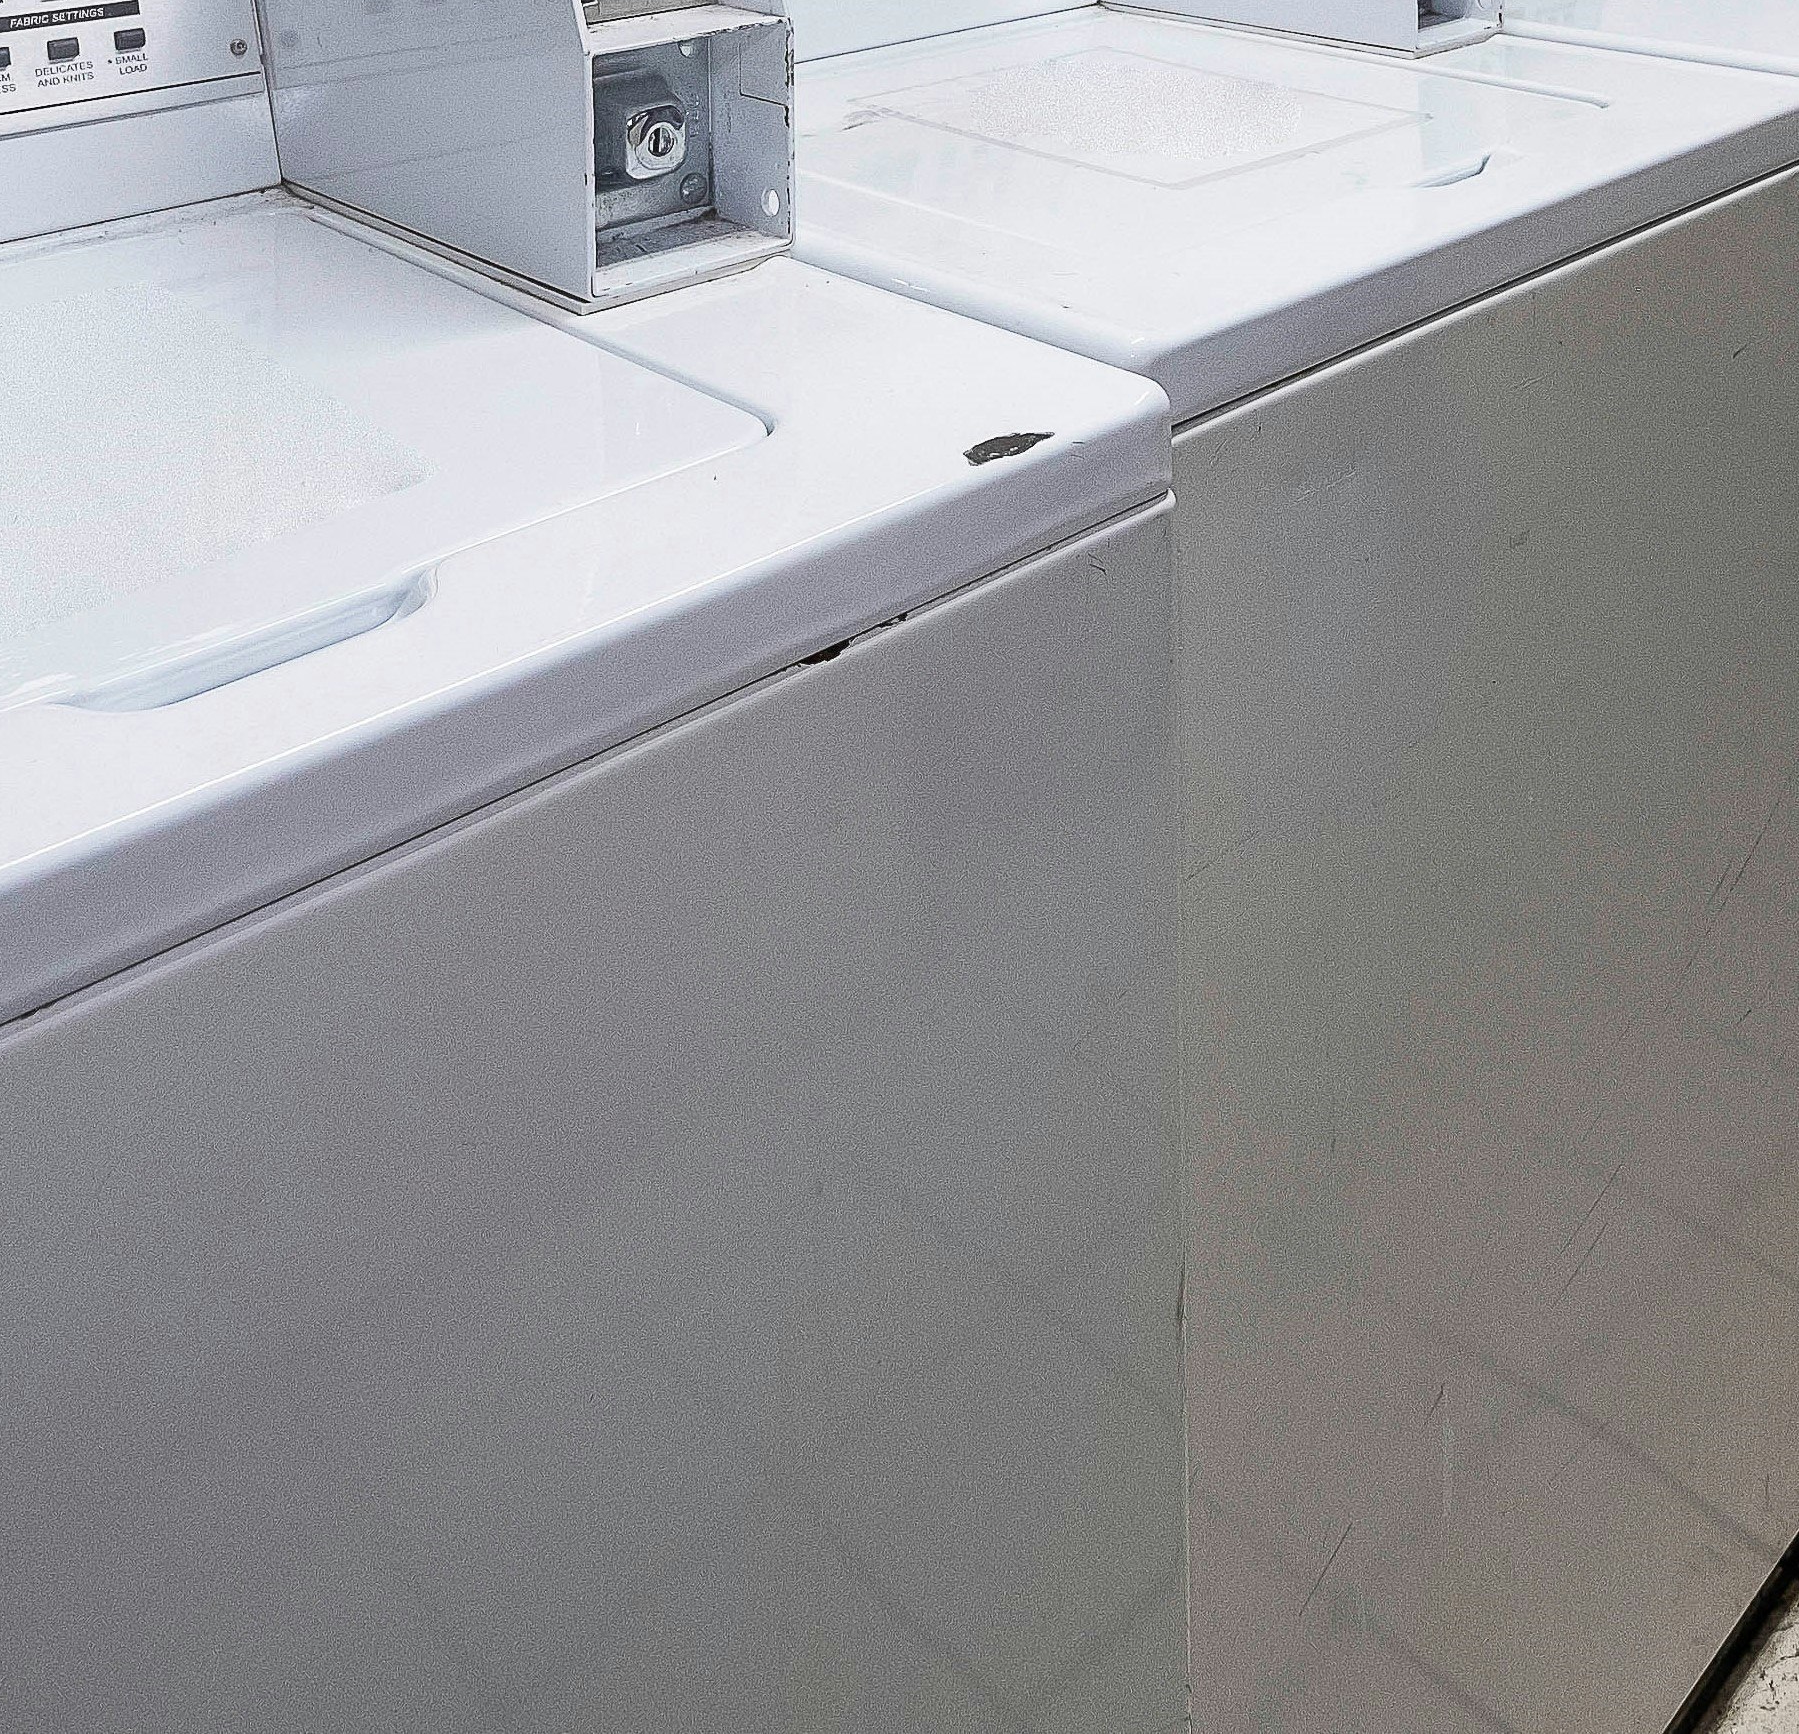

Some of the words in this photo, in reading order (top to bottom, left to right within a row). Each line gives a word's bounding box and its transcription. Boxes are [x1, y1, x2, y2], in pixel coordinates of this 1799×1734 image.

[10, 14, 49, 28] FABRIC
[52, 7, 104, 23] SETTINGS
[115, 53, 149, 65] SMALL
[35, 61, 94, 77] DELICATES
[119, 64, 148, 75] LOAD
[37, 77, 61, 88] AND
[63, 71, 95, 84] KNITS
